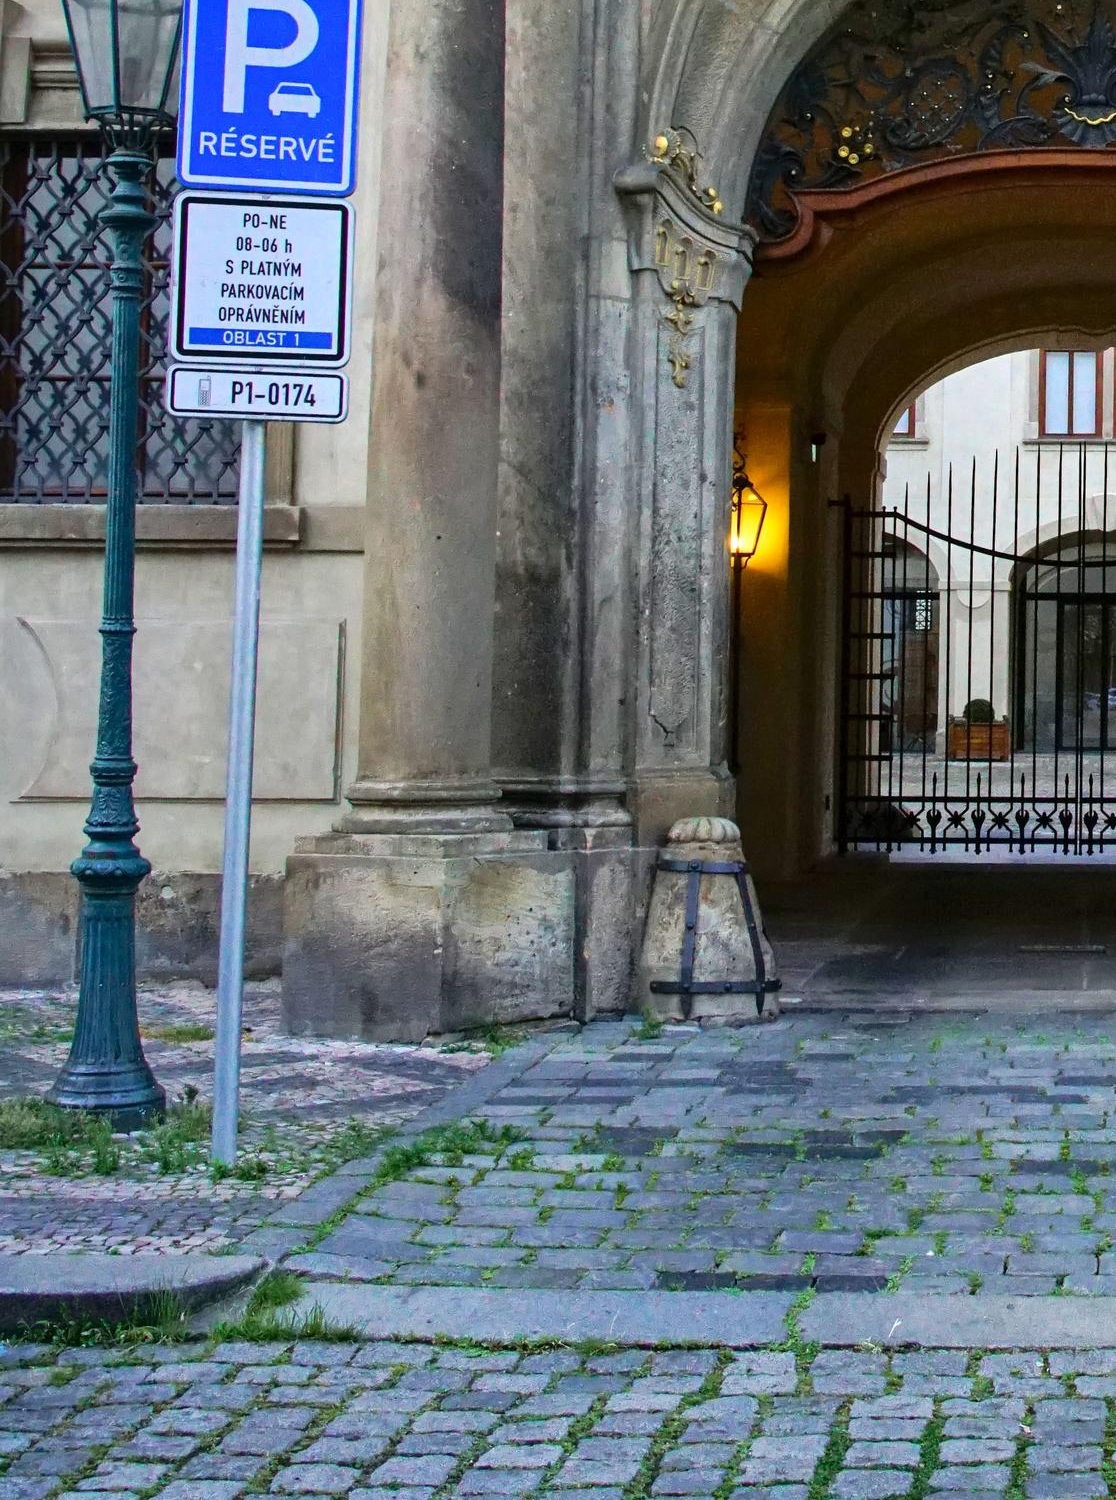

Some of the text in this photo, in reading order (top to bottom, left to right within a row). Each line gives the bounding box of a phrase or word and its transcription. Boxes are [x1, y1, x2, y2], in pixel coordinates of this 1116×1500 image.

[199, 127, 335, 163] RÉSERVÉ
[243, 213, 287, 229] PO-NE
[236, 236, 292, 253] 08-06 h
[225, 259, 301, 277] S PLATNÝM
[221, 282, 304, 301] PARKOVACÍM
[218, 304, 305, 325] OPRÁVNĚNÍM
[223, 331, 300, 346] OBLAST 1
[231, 381, 316, 407] P1-0174
